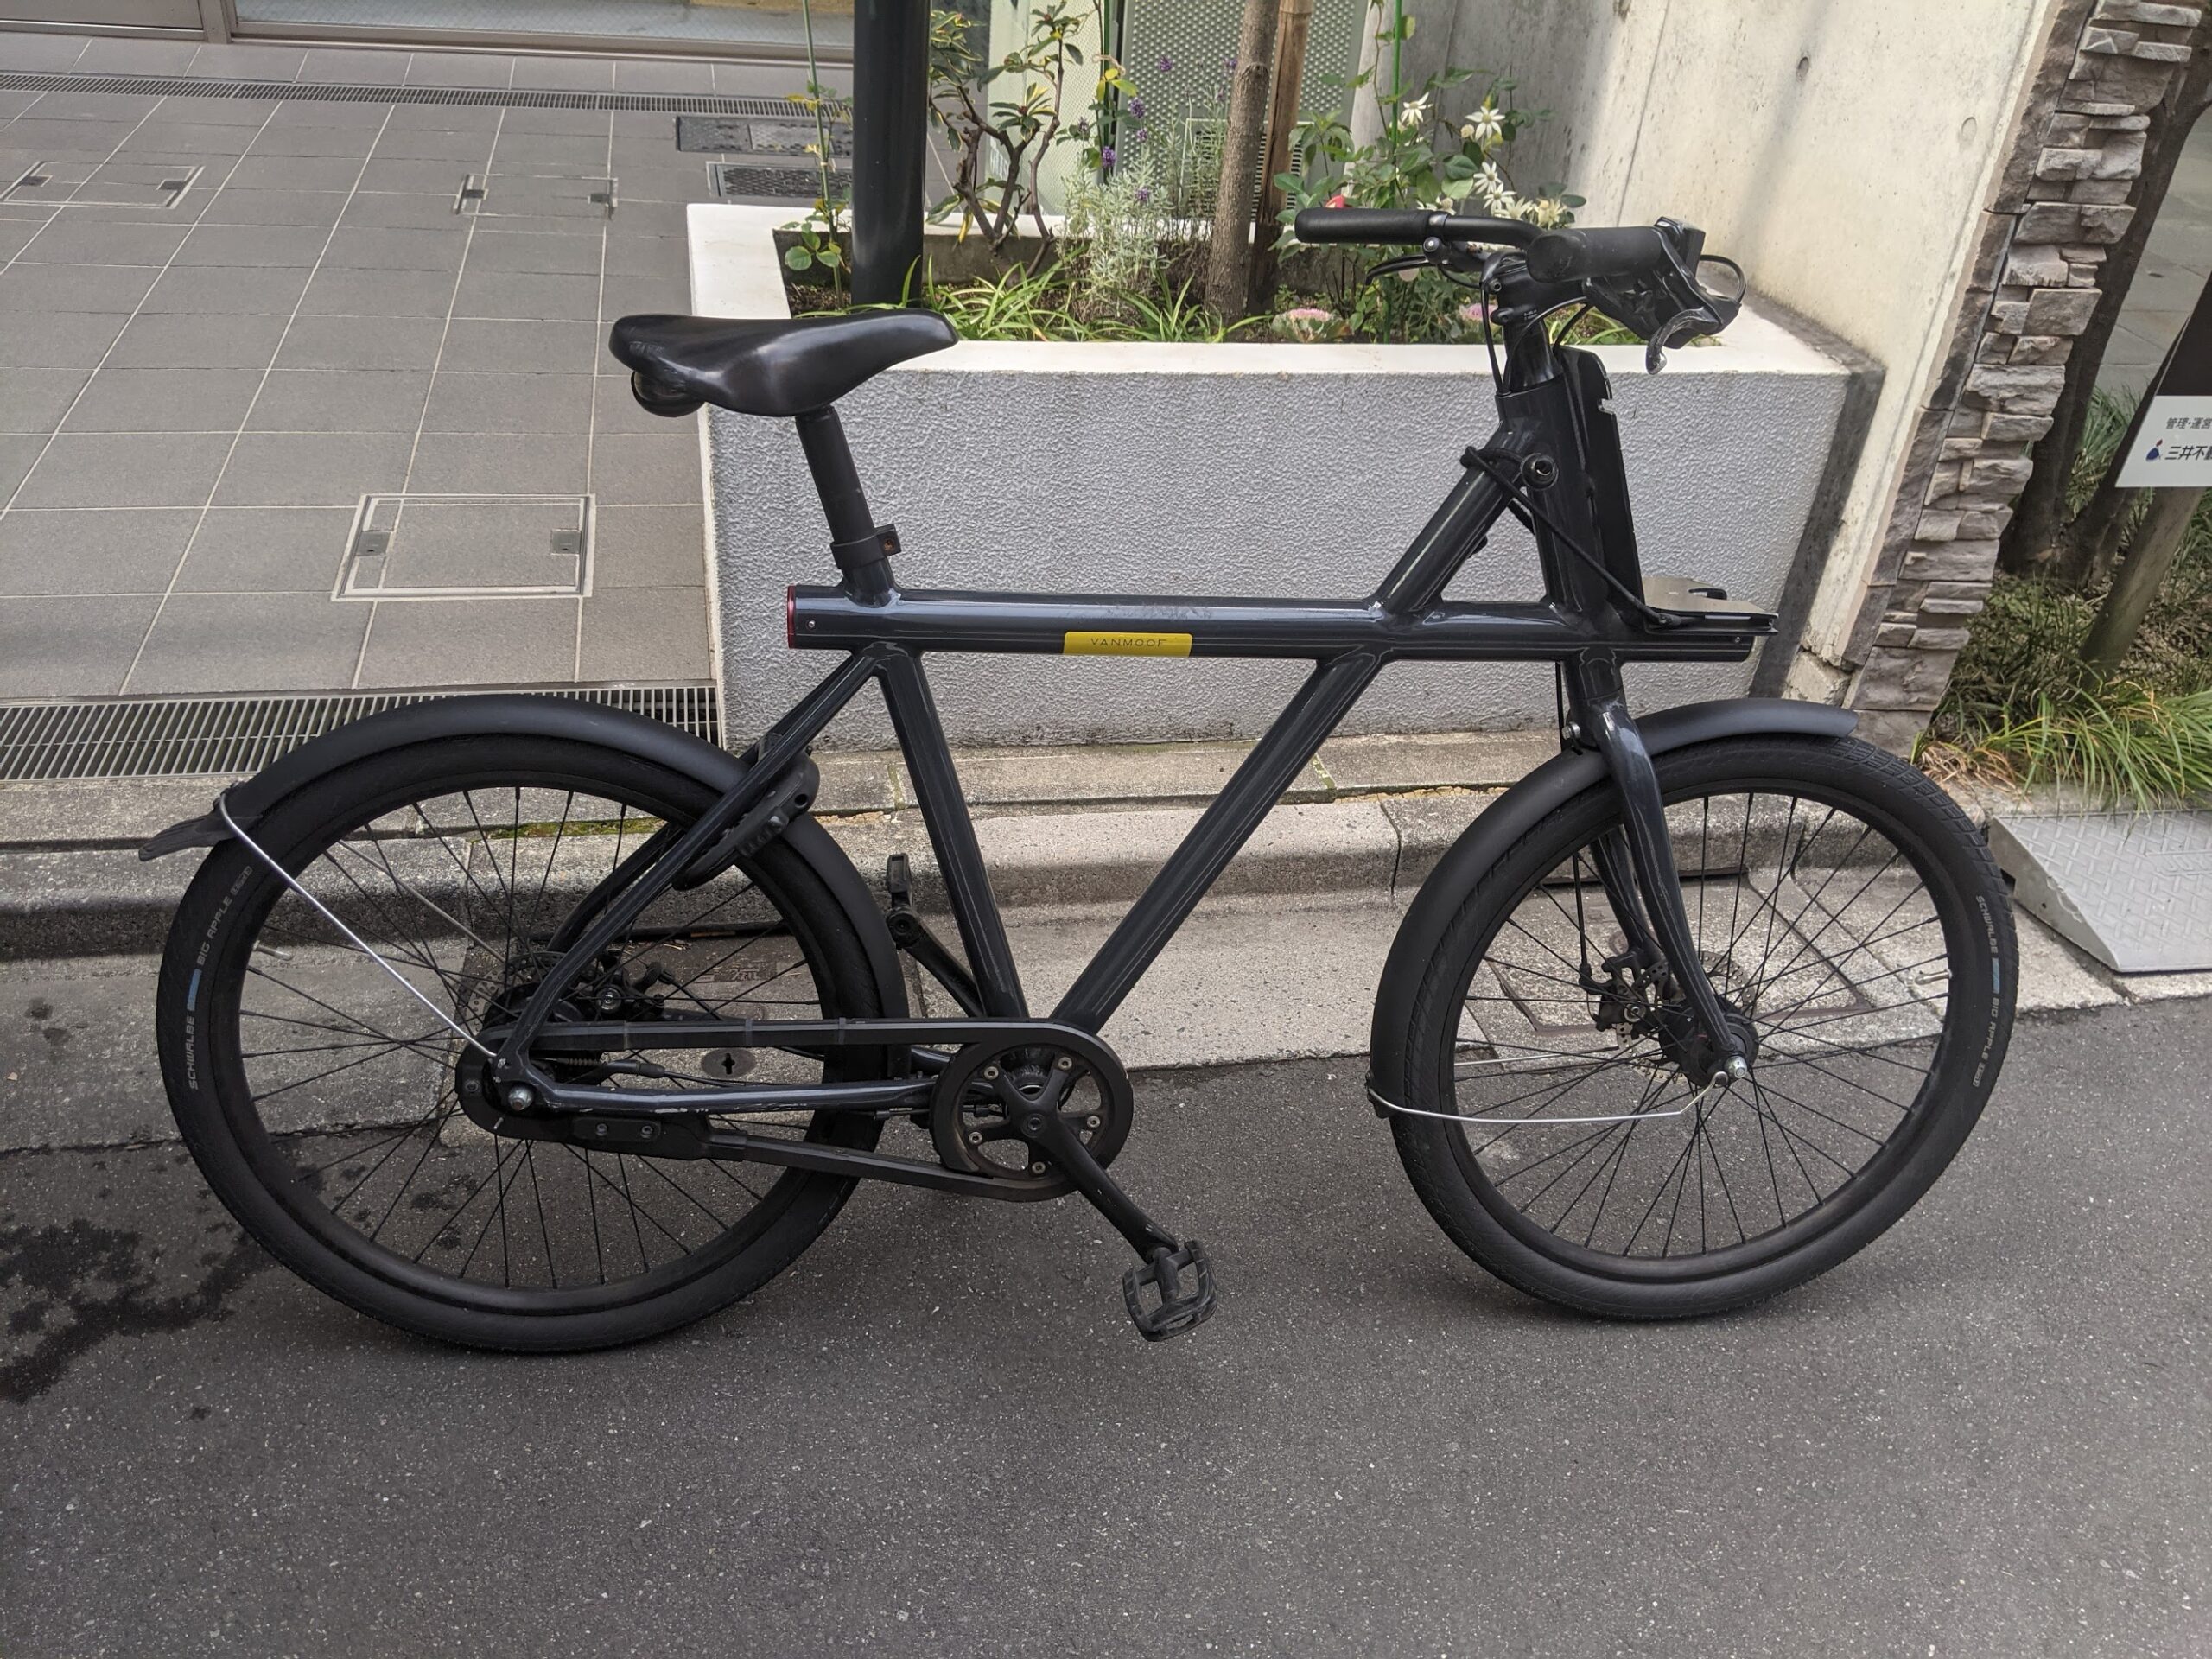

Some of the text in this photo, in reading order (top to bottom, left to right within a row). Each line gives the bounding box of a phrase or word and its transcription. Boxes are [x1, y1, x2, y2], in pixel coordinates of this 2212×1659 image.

[1090, 638, 1167, 648] VANMOOF
[1975, 894, 1999, 955] SCHWALBE
[186, 895, 233, 1091] SCHWALBE BIG APPLE
[1980, 1021, 1997, 1061] APPLE
